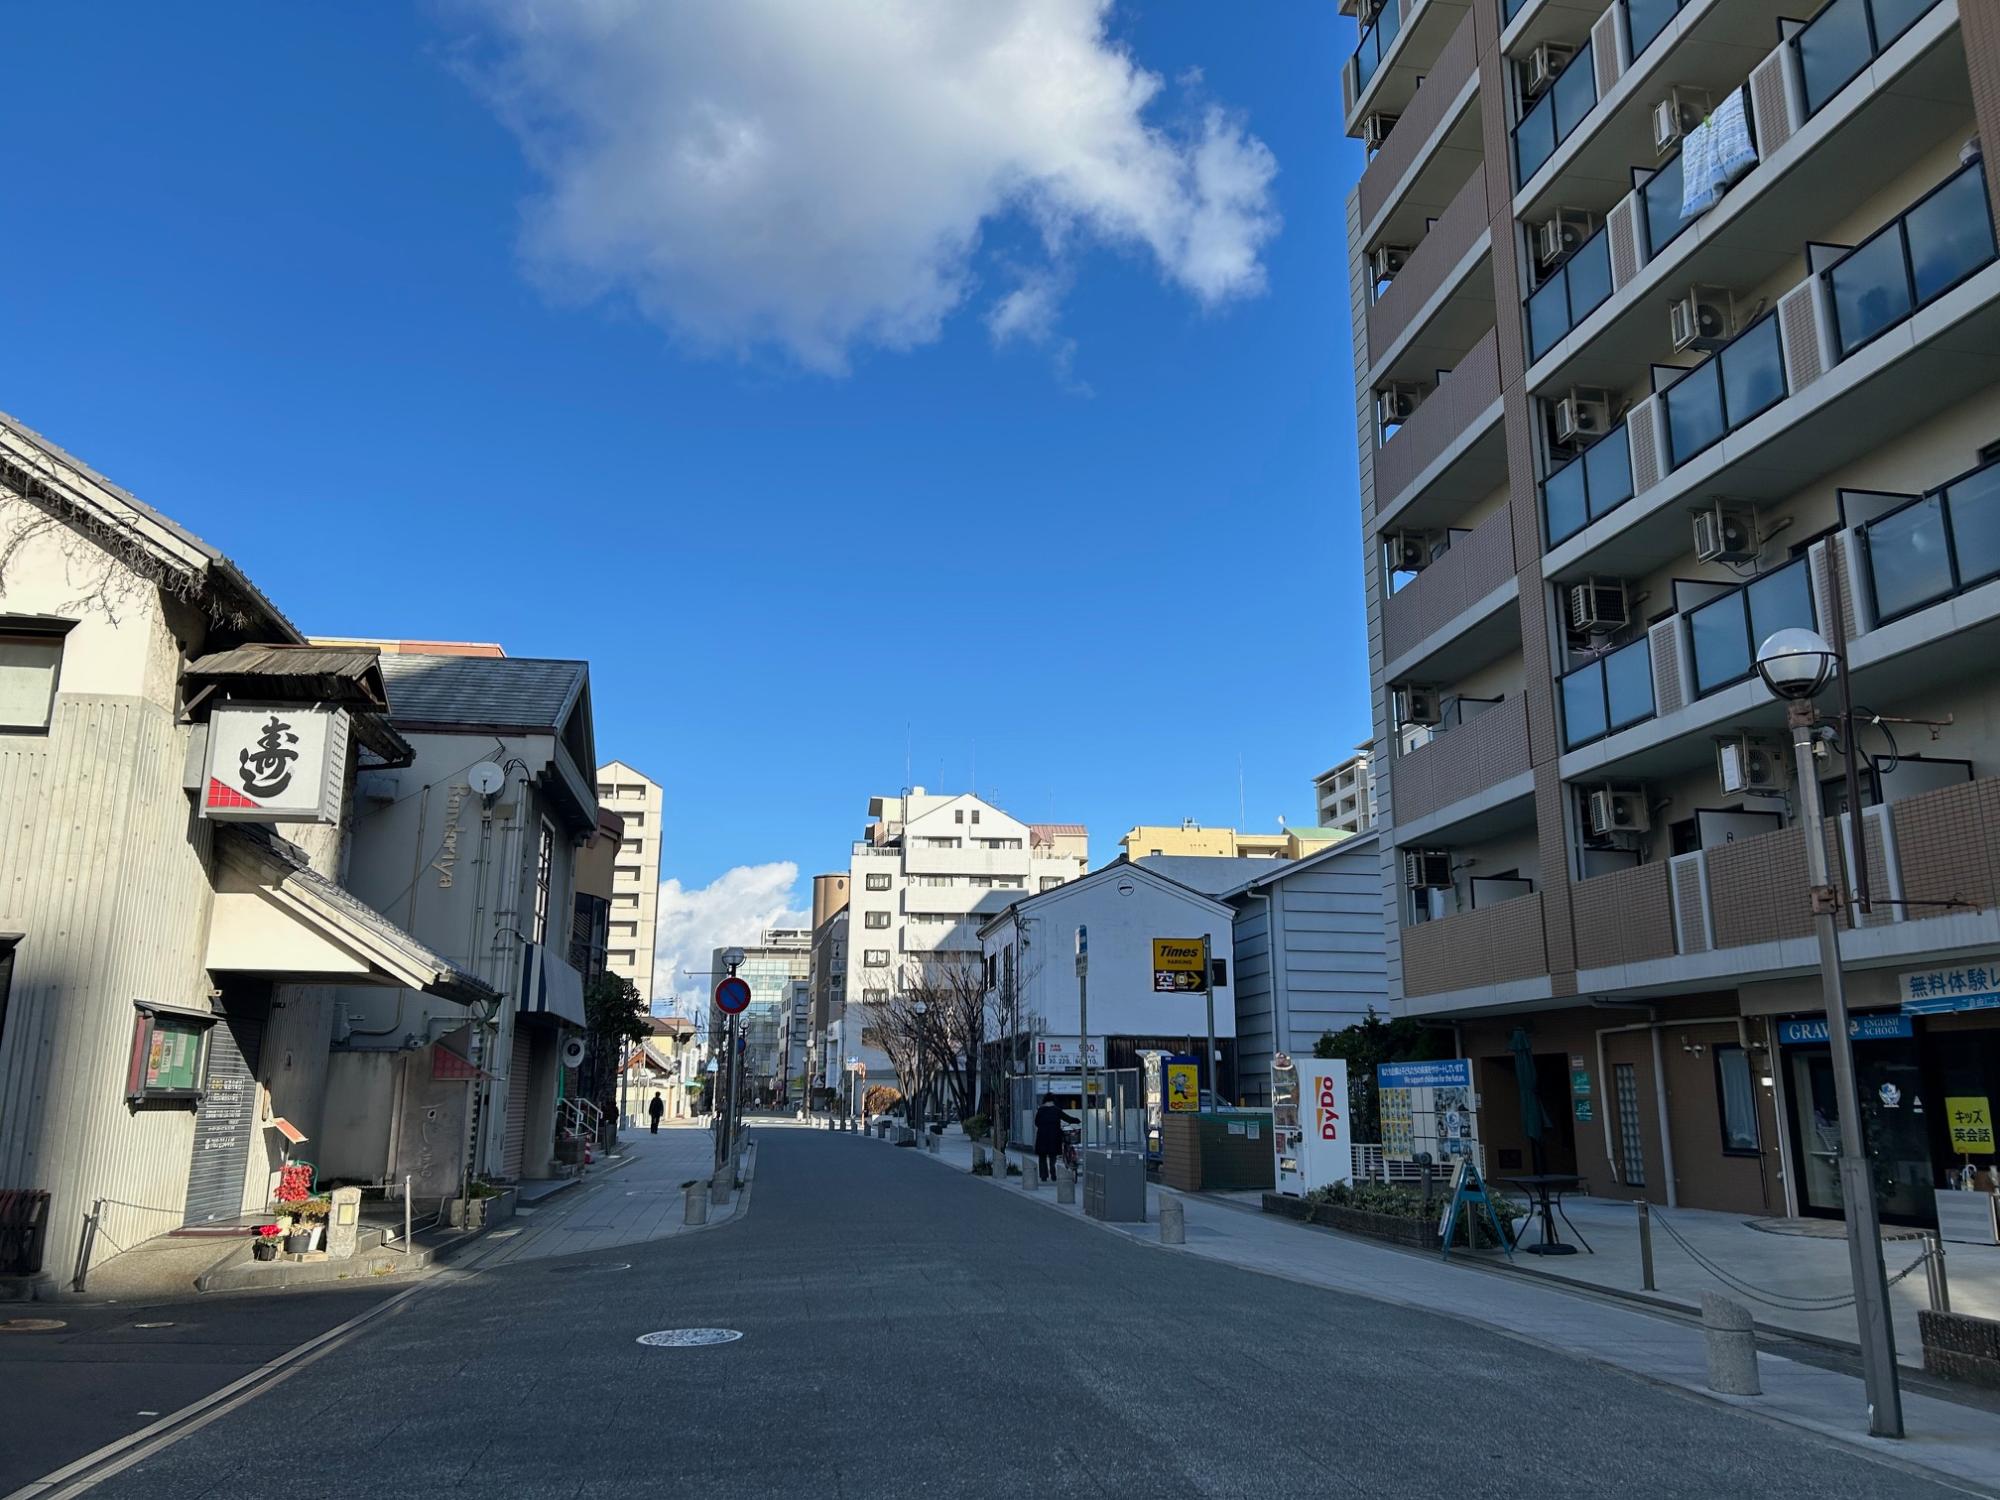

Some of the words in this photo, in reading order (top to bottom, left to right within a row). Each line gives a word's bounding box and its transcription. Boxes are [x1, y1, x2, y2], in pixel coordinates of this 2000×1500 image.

[1160, 945, 1199, 957] Times
[1156, 971, 1175, 990] 空
[1909, 967, 2000, 999] 無料体験レ
[1864, 1016, 1899, 1028] ENGLISH
[1788, 1021, 1831, 1040] GRAV
[1863, 1025, 1900, 1036] SCHOOL
[1320, 1076, 1340, 1140] DyDo
[1955, 1110, 1985, 1124] キッズ
[1953, 1128, 1991, 1143] 英会話
